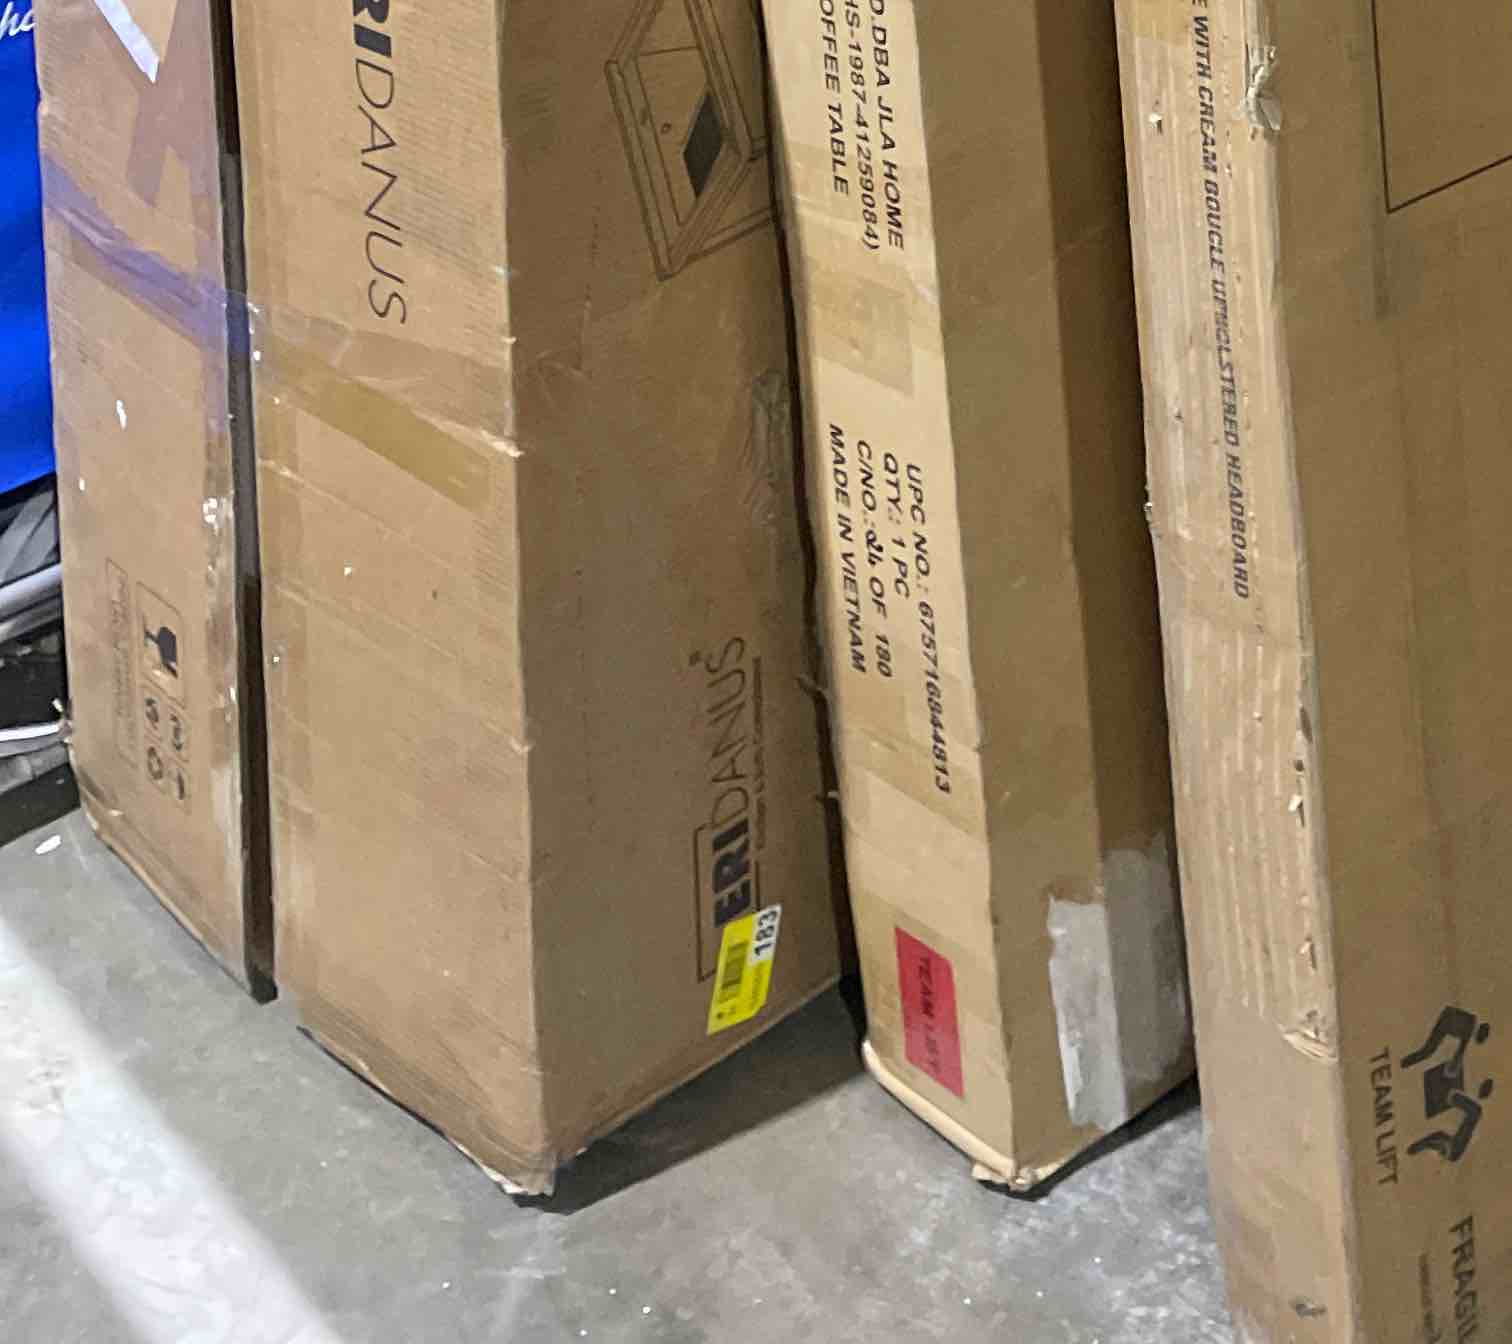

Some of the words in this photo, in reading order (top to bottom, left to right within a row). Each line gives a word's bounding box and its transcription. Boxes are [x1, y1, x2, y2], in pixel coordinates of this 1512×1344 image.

[1192, 15, 1212, 82] WITH
[828, 102, 849, 196] TABLE
[878, 96, 895, 150] JLA
[1197, 87, 1218, 173] CREAM
[883, 162, 904, 250] HOME
[1202, 179, 1225, 271] BOUCLE
[829, 423, 851, 509] MADE
[837, 518, 853, 542] IN
[1225, 453, 1251, 600] HEADBOARD
[841, 552, 866, 673] VIETNAM
[870, 577, 886, 619] OF
[893, 558, 910, 599] PC
[875, 634, 893, 678] 180
[906, 464, 925, 526] UPC
[918, 601, 950, 794] 675716844813
[707, 636, 752, 929] ERIDANUS
[751, 906, 779, 958] 183
[918, 955, 935, 1019] TEAM
[1369, 1049, 1396, 1126] TEAM
[1374, 1130, 1398, 1185] LIFT
[1449, 1215, 1479, 1344] FRAGIL
